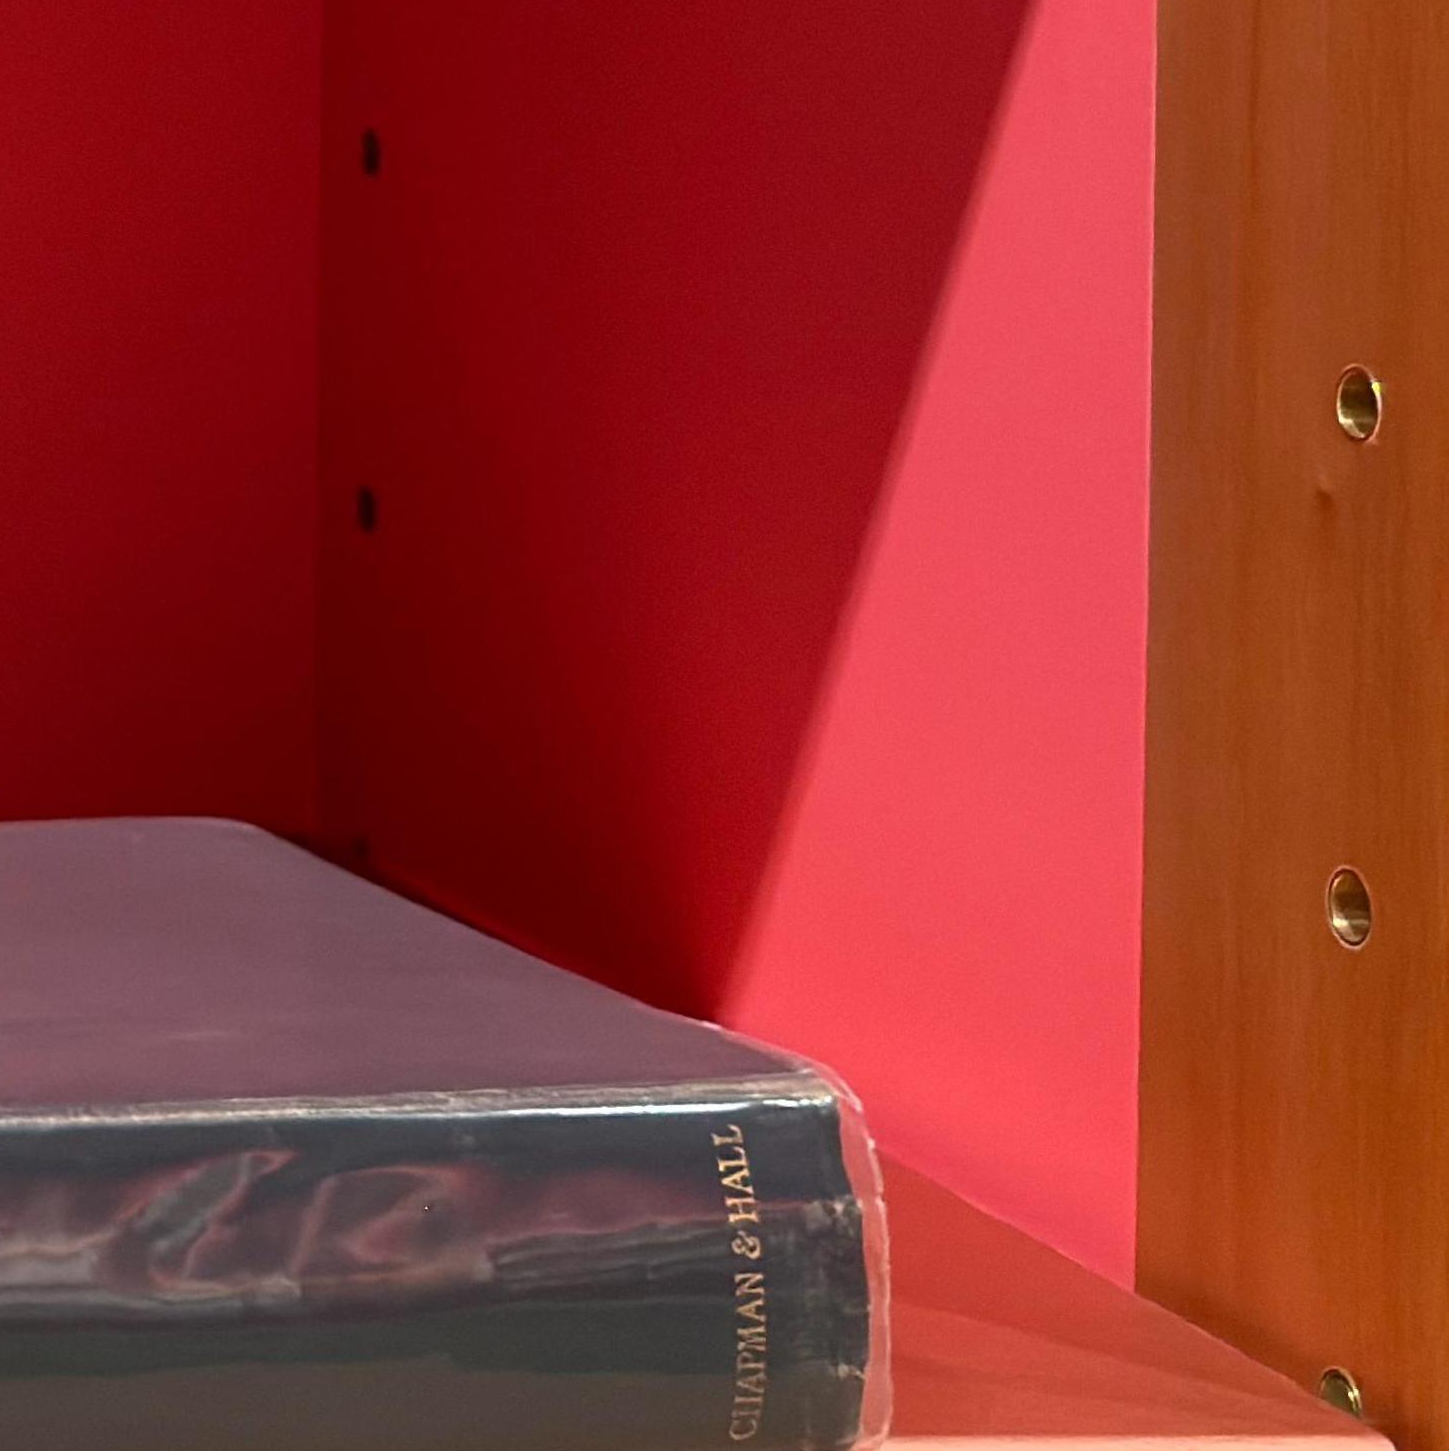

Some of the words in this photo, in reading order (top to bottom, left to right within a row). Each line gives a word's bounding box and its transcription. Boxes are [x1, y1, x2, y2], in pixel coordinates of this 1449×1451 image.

[711, 1124, 760, 1225] HALL
[730, 1230, 762, 1260] &
[729, 1272, 768, 1441] CHAPMAN
